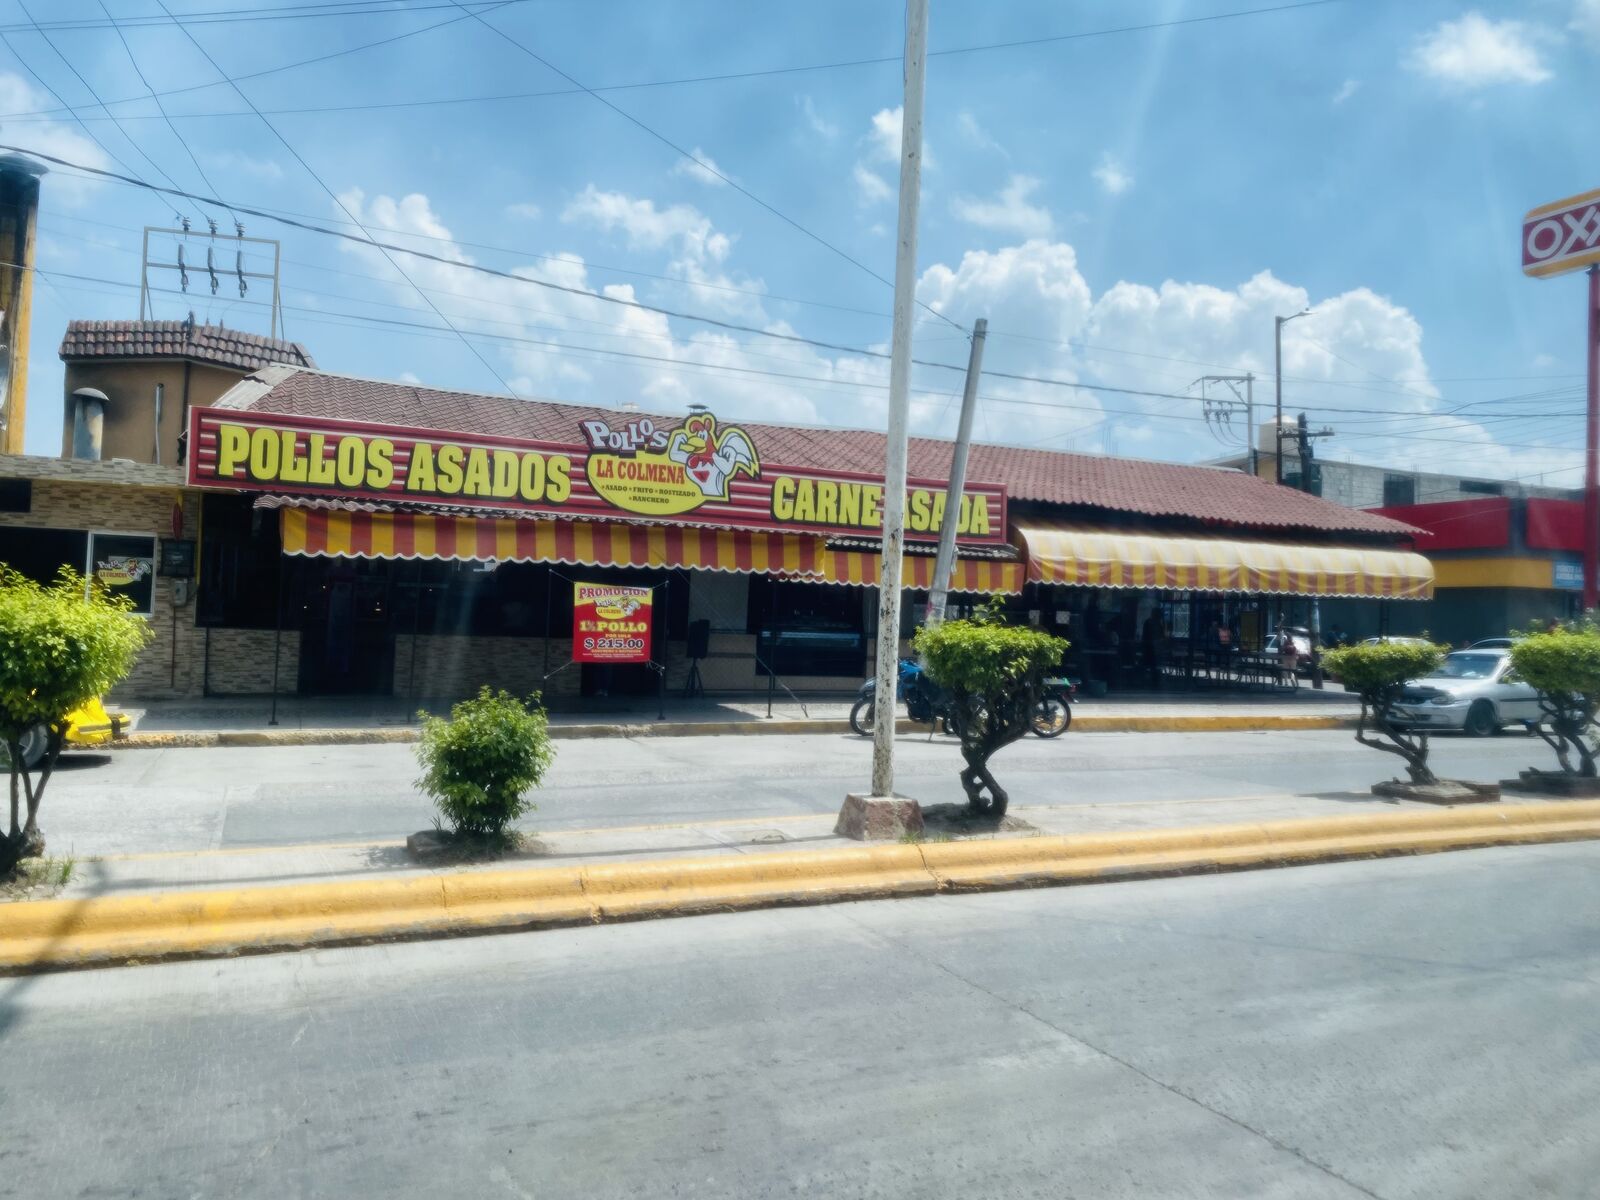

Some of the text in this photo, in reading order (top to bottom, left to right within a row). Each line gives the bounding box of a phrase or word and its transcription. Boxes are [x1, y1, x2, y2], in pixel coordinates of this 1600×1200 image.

[218, 423, 572, 503] POLLOS ASADOS
[596, 459, 686, 485] LA COLMENA
[605, 485, 628, 493] ASADO
[658, 488, 696, 497] ROSTIZADO
[632, 495, 670, 504] RANCHERO
[772, 476, 991, 535] CARNE SADA
[596, 621, 647, 632] POLLO
[597, 638, 644, 649] 215.00
